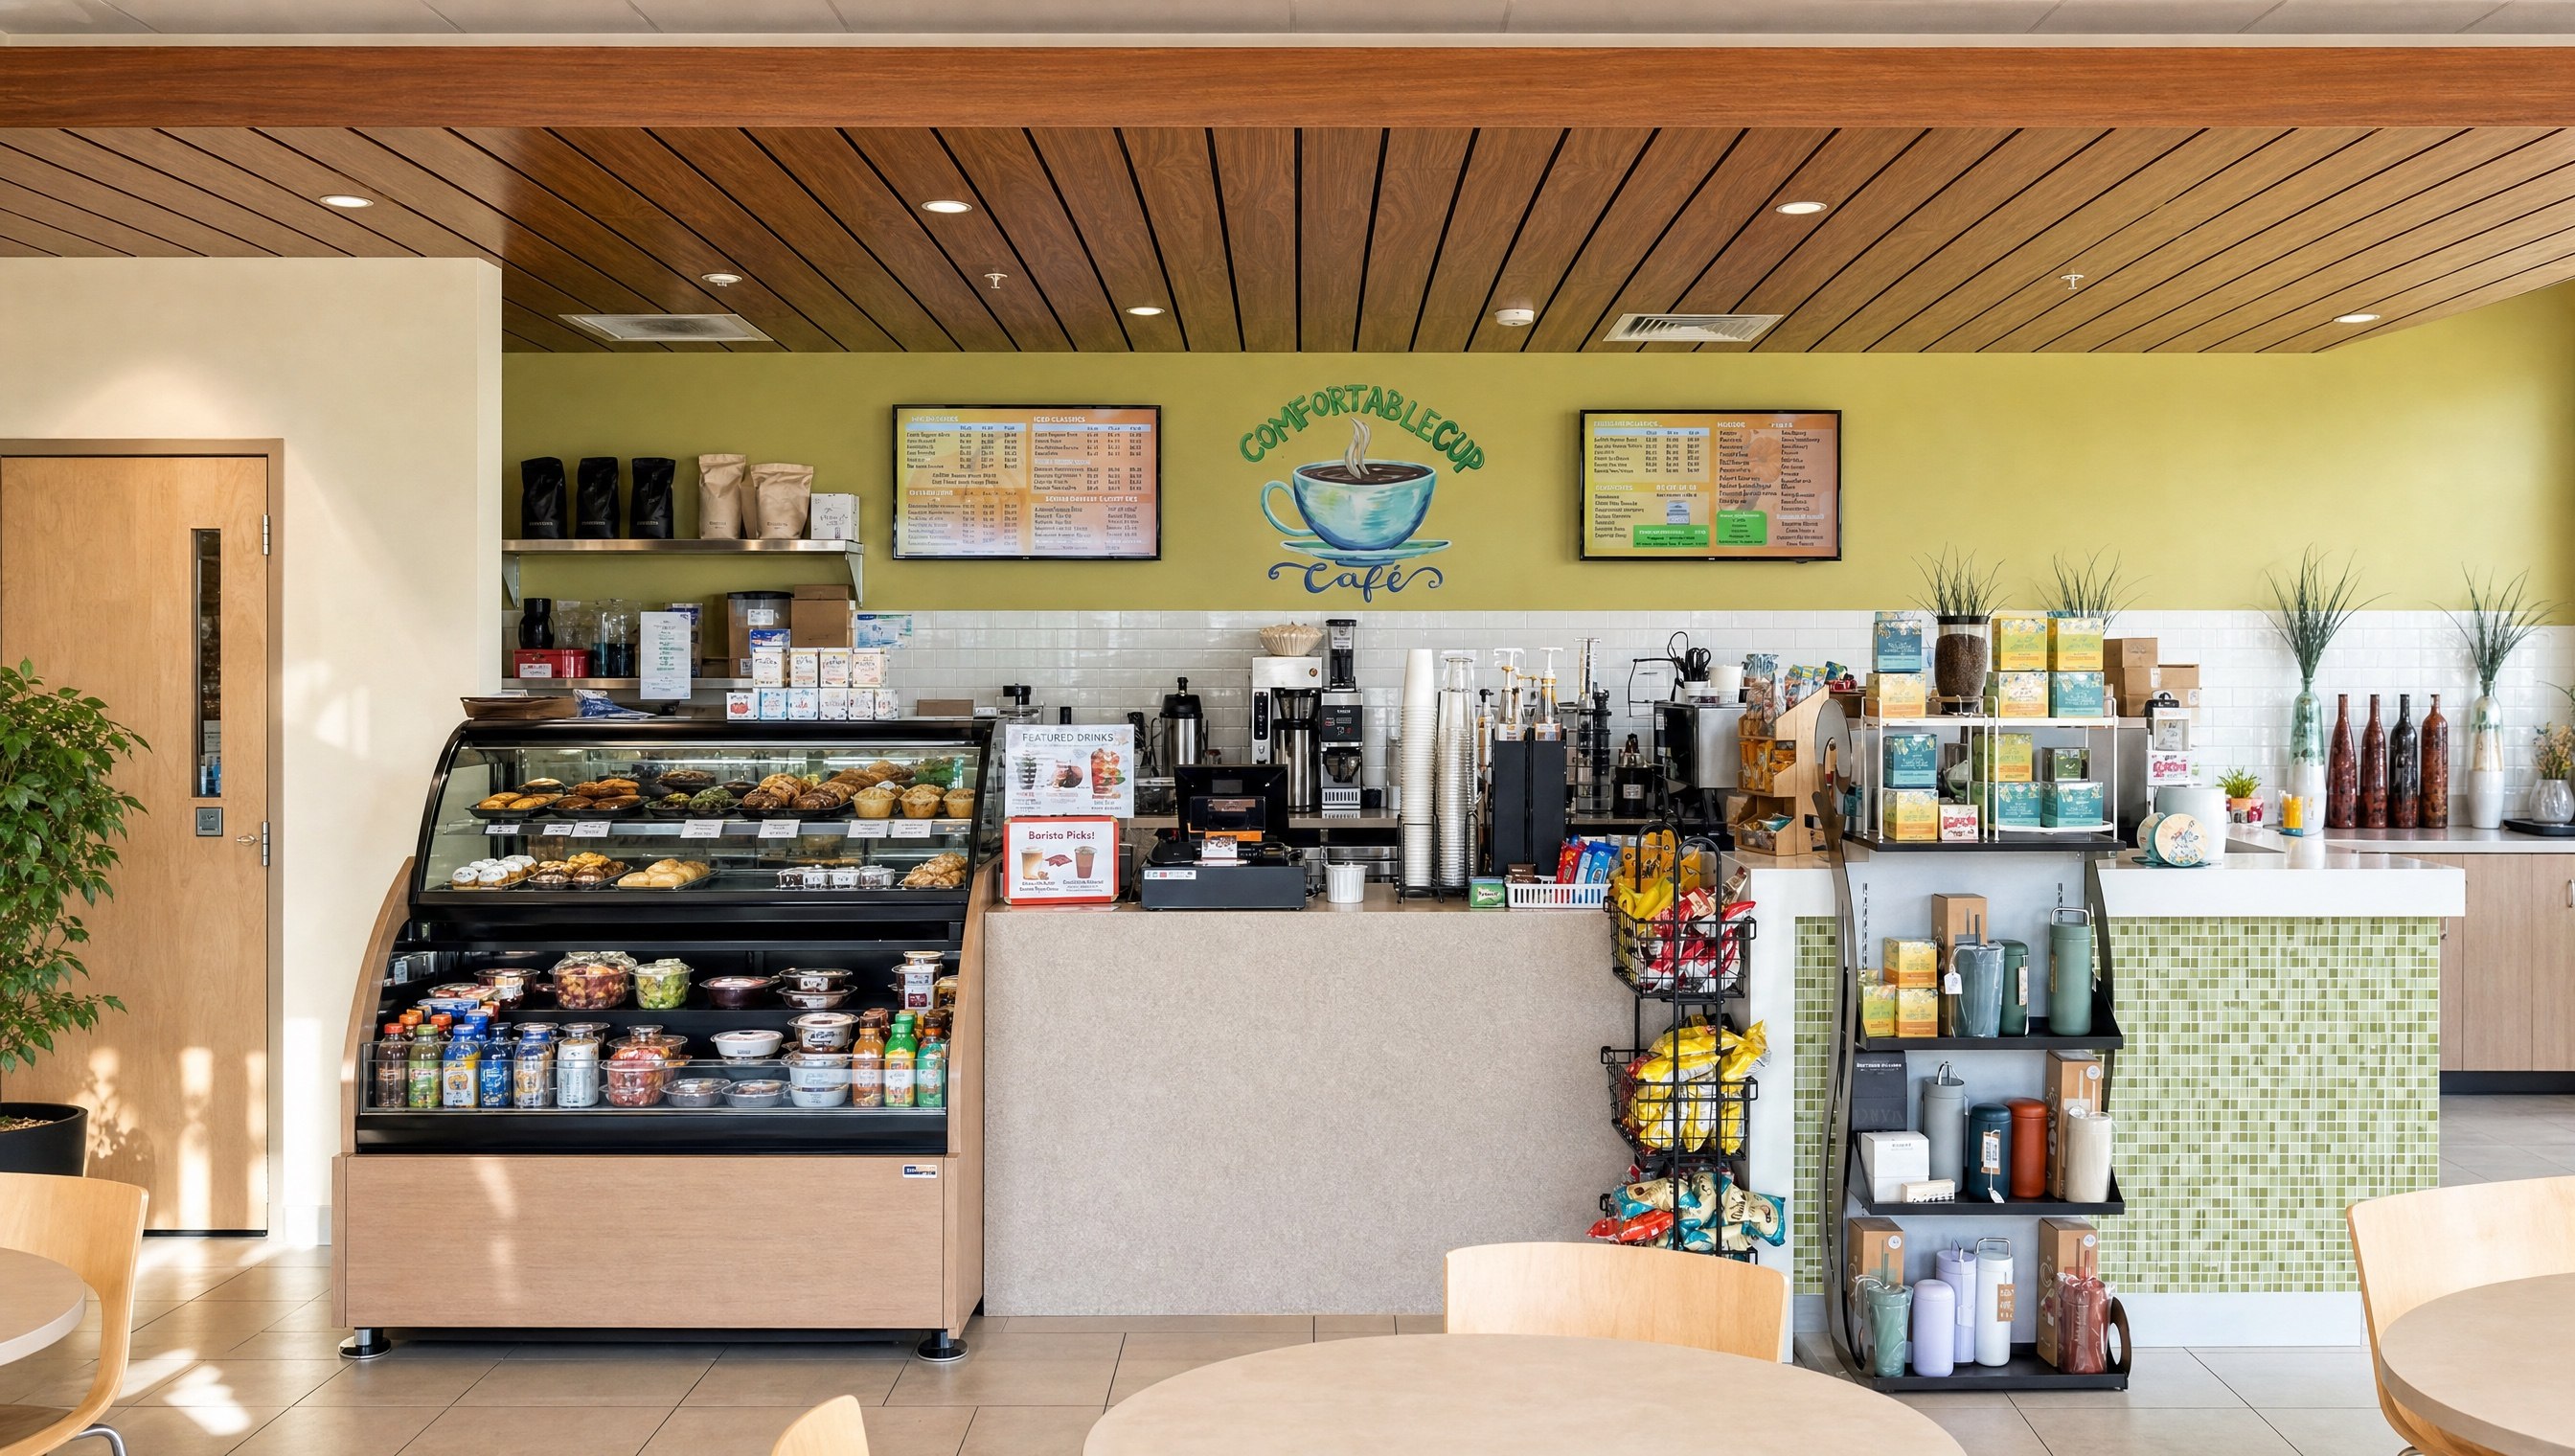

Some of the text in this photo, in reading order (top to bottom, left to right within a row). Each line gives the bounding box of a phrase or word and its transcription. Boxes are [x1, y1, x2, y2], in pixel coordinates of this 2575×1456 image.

[1267, 561, 1444, 603] Café
[1022, 733, 1114, 742] FEATURED DRINKS
[1028, 830, 1095, 840] Barista Picks!
